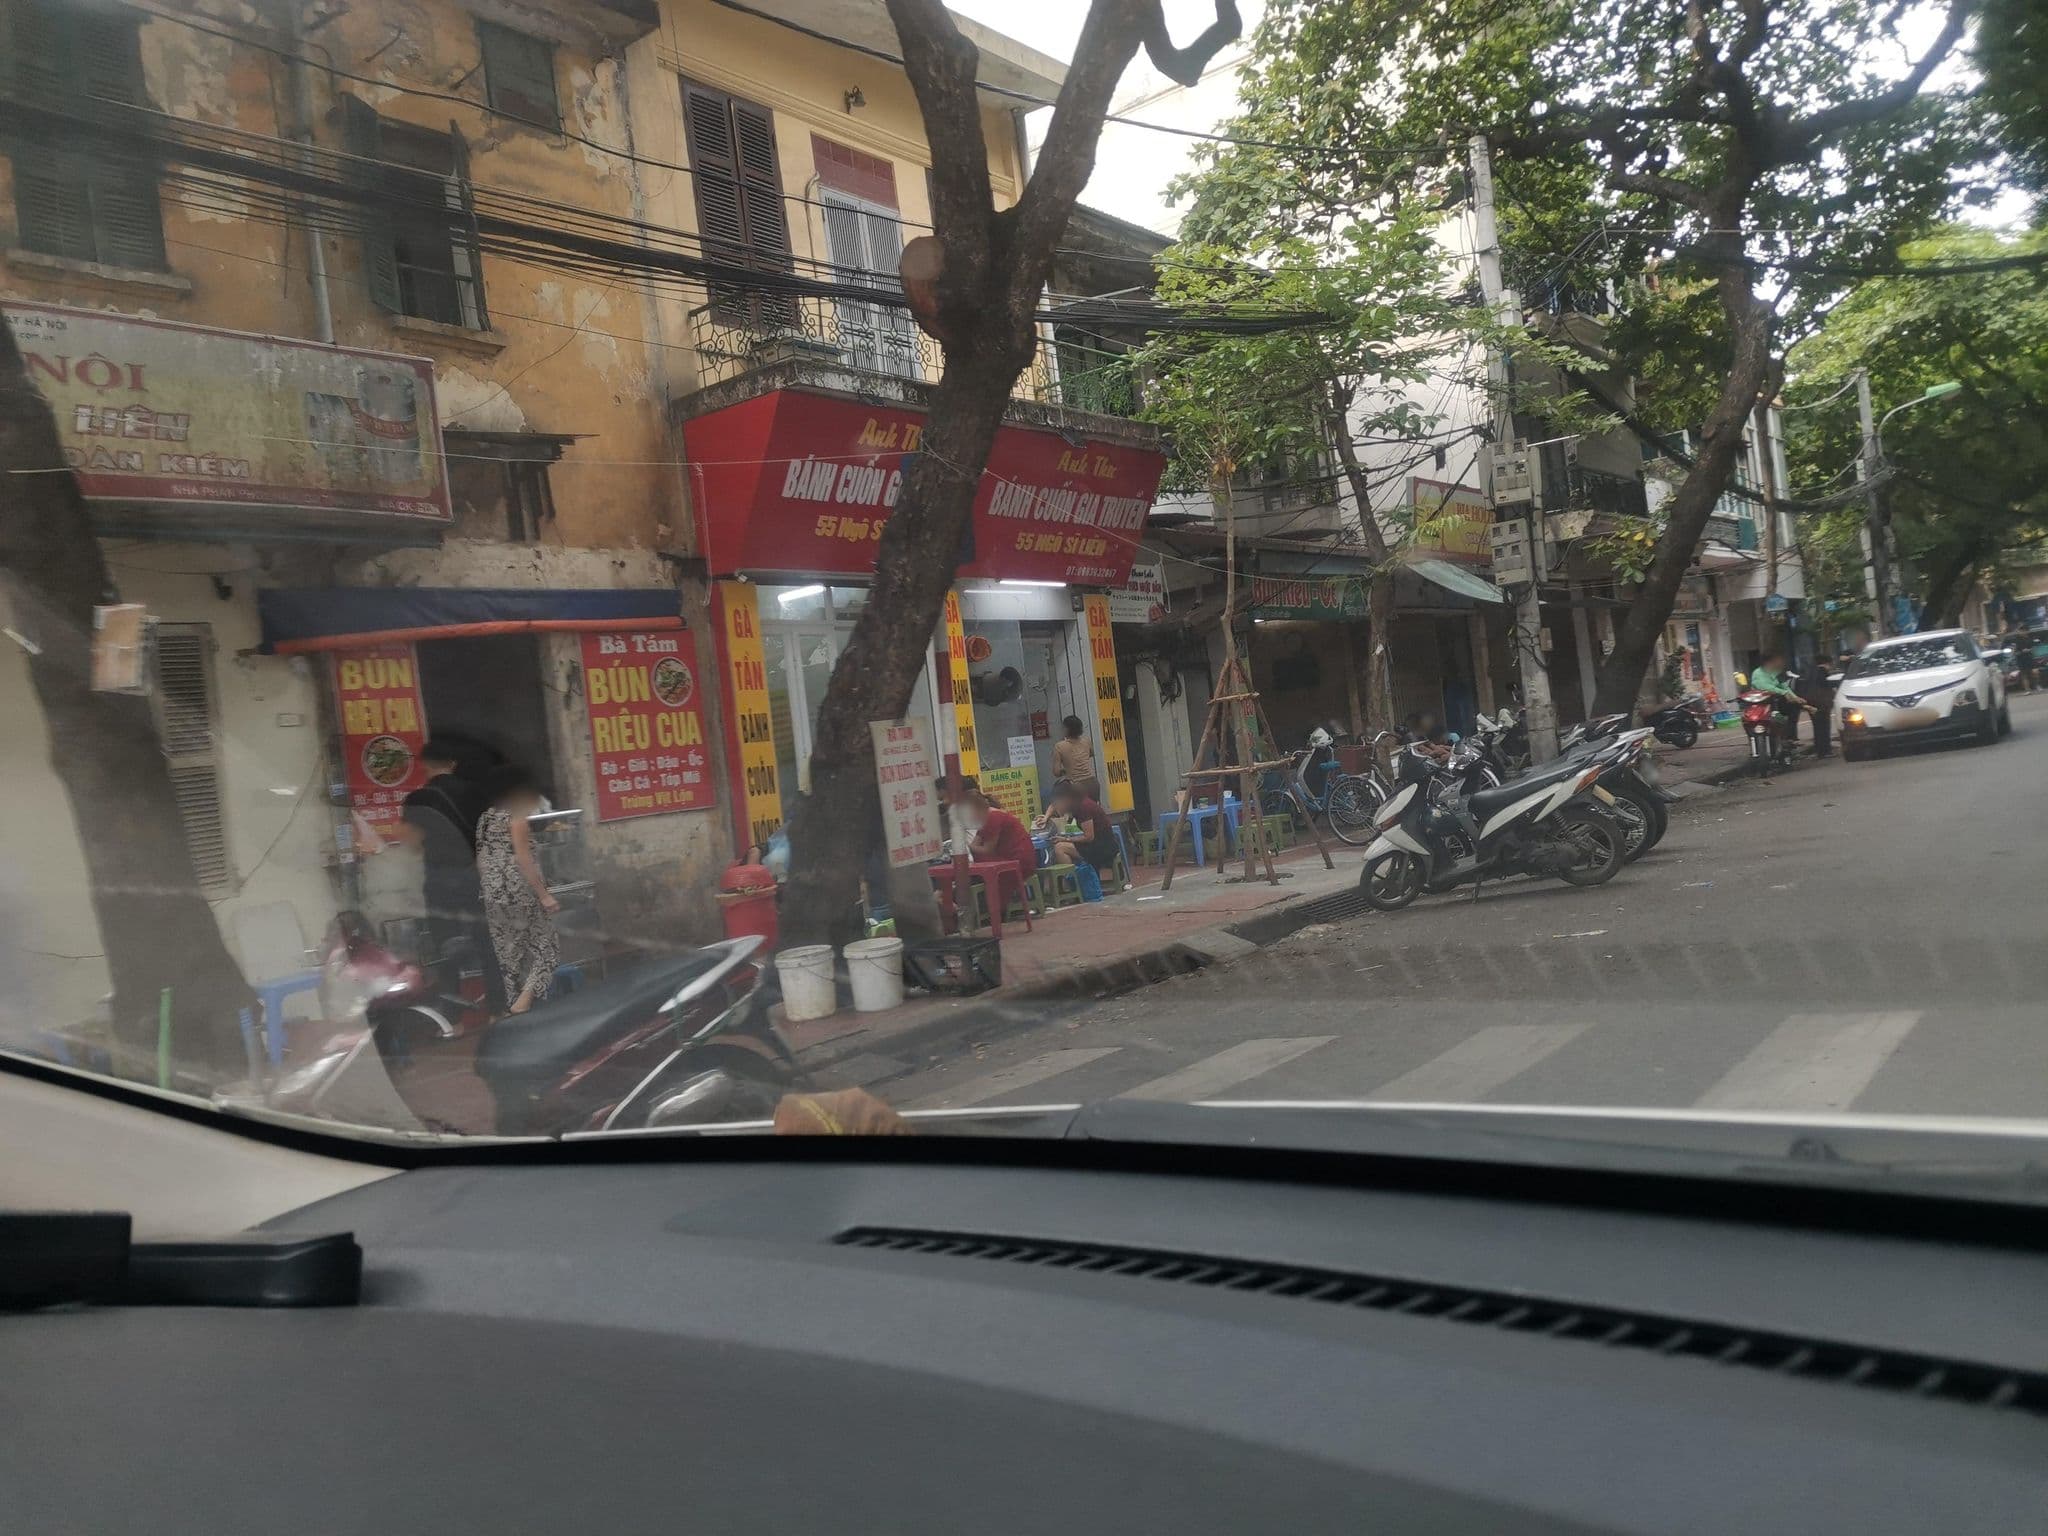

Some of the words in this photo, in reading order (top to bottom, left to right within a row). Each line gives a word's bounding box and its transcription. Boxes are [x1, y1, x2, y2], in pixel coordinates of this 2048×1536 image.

[22, 351, 149, 396] NỘI
[159, 451, 249, 479] KIẾM
[781, 453, 838, 502] BÁNH
[835, 453, 886, 506] CUỐN
[988, 475, 1037, 520] BÁNH
[1033, 480, 1078, 523] CUỐN
[1073, 491, 1101, 528] GIA
[814, 514, 838, 537] 55
[1015, 530, 1035, 552] 55
[733, 604, 753, 639] GÀ
[1089, 601, 1108, 629] GÀ
[600, 635, 627, 655] Bà
[632, 634, 679, 652] Tám
[341, 652, 413, 691] BÚN
[587, 659, 650, 705] BÚN
[1096, 673, 1117, 700] BÁNH
[592, 707, 650, 753] RIÊU
[656, 710, 703, 748] CUA
[740, 709, 770, 743] BÁNH
[1102, 709, 1122, 743] CUỐN
[746, 754, 776, 798] CUỐN
[1107, 755, 1128, 785] NÓNG
